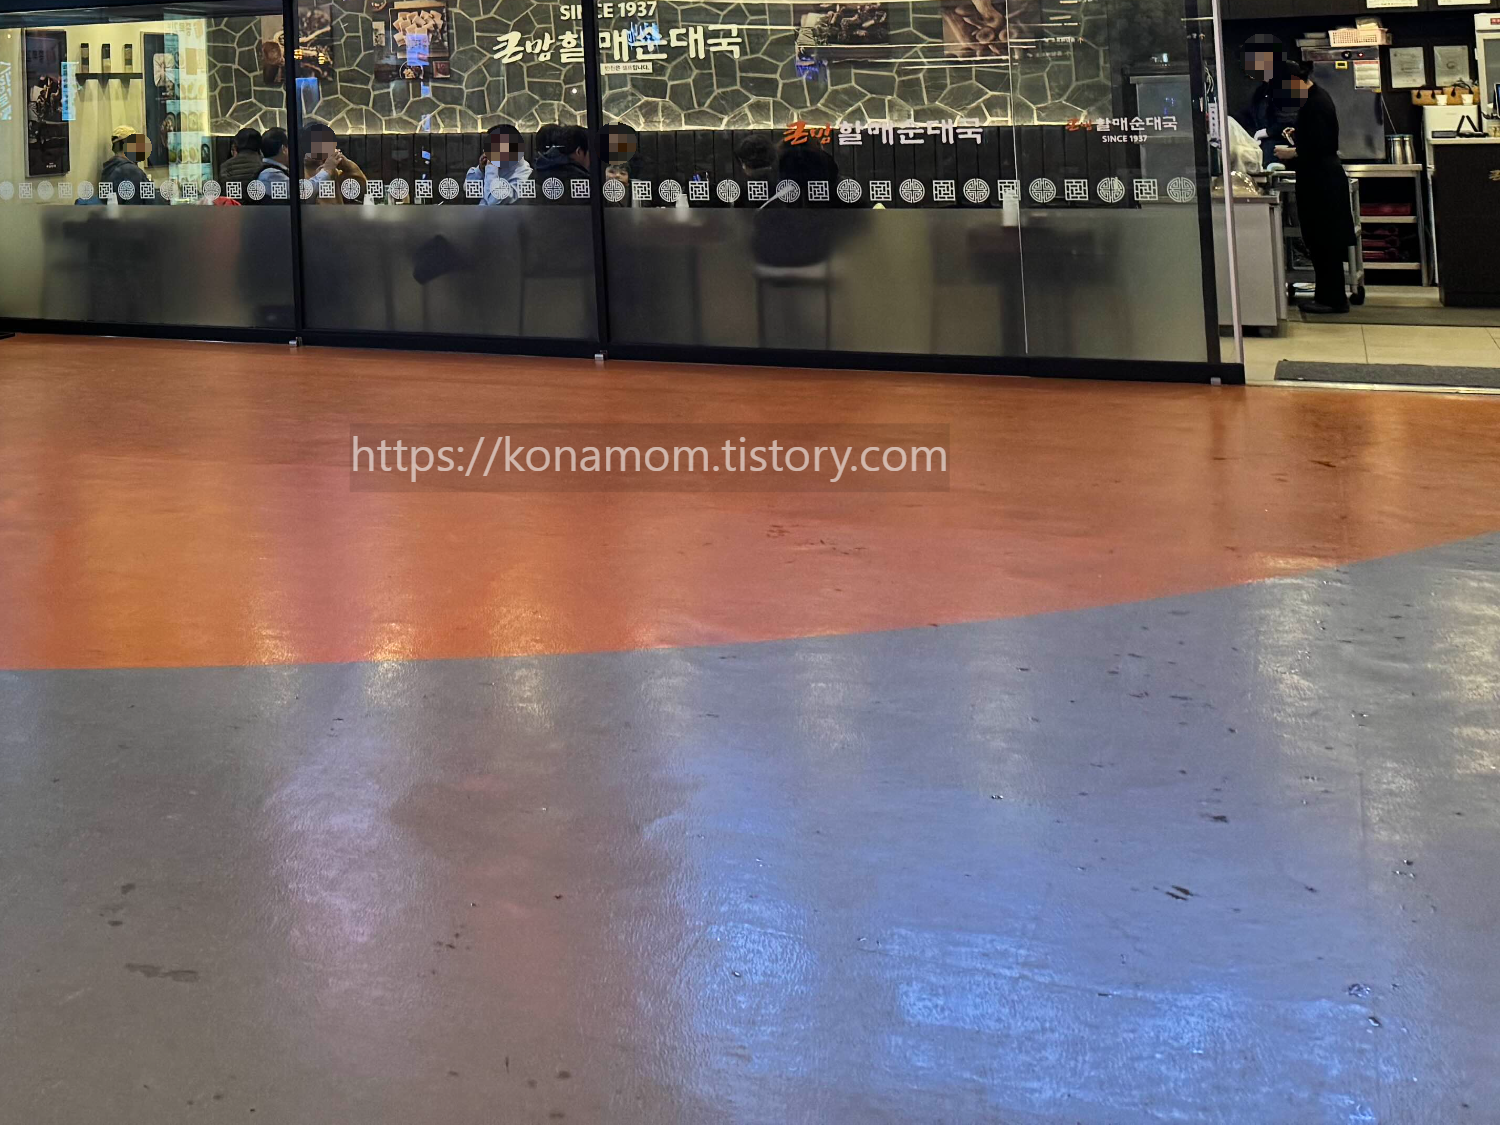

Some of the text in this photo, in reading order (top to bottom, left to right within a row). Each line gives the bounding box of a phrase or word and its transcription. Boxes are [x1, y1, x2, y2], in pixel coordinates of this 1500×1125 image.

[617, 0, 658, 19] 1937
[492, 24, 743, 64] 큰맘 할매순대국
[782, 116, 984, 146] 큰맘 할매순대국
[1095, 115, 1178, 131] 할매순대국
[1101, 133, 1148, 143] SINCE 1937
